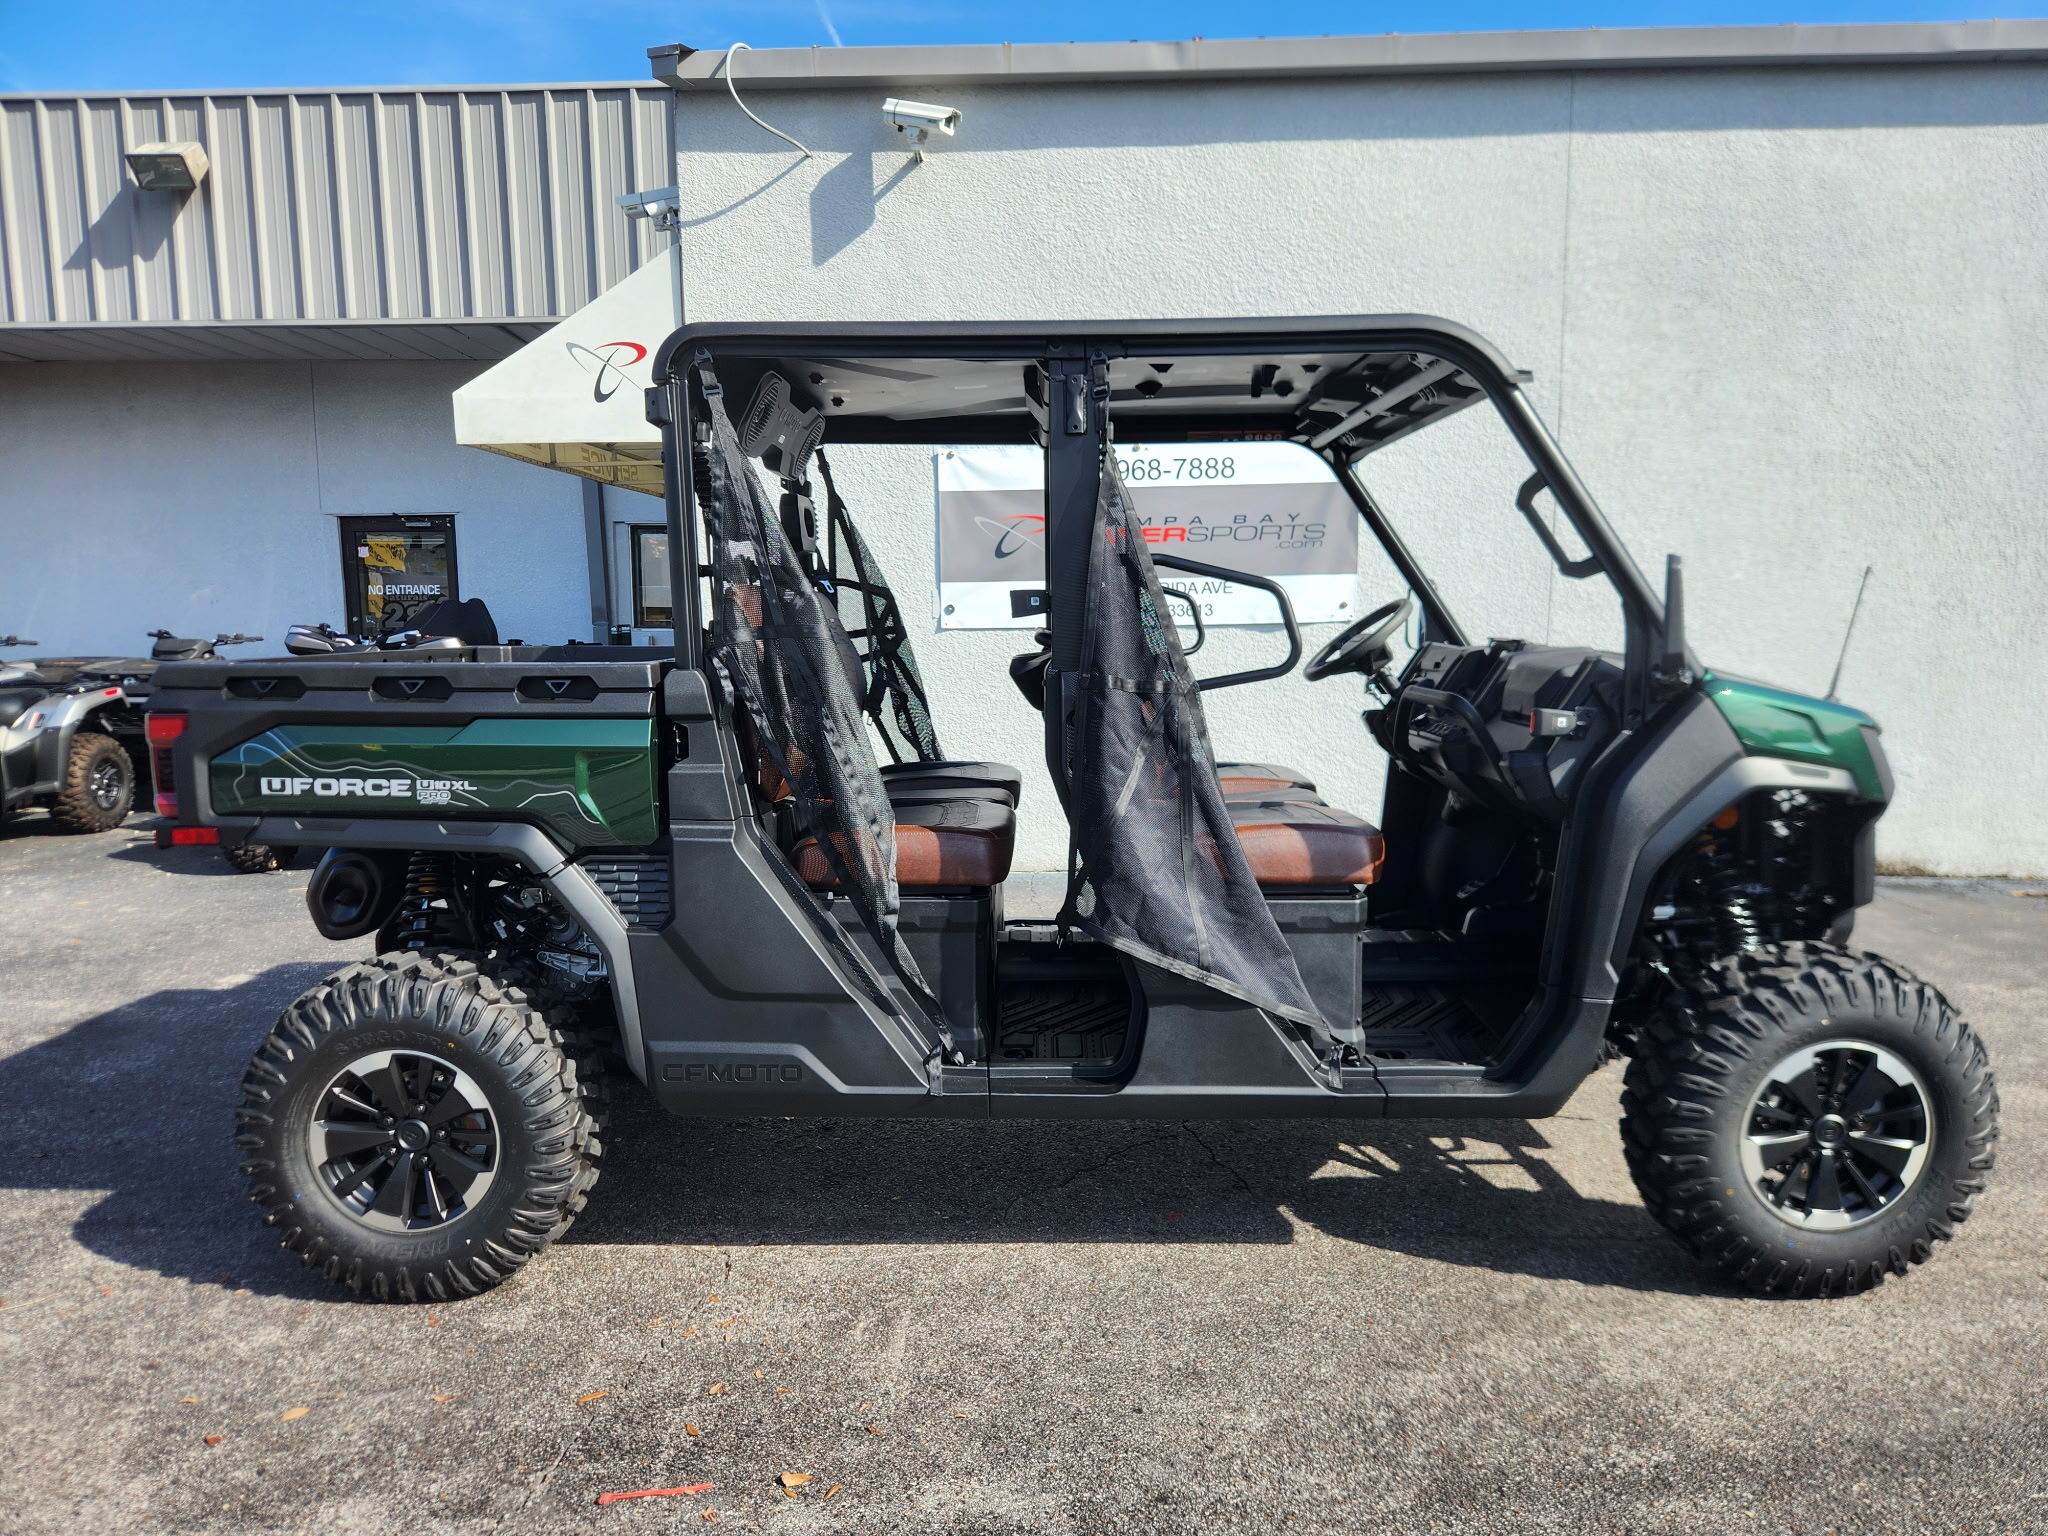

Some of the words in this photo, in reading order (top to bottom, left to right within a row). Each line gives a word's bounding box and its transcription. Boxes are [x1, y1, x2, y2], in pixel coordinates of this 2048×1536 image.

[1137, 515, 1203, 526] MPA
[1233, 513, 1300, 525] BAY
[1275, 539, 1323, 549] .com
[368, 585, 383, 595] NO
[386, 584, 440, 595] ENTRANCE
[1201, 581, 1233, 594] AVE
[261, 777, 412, 797] UFORCE
[416, 790, 451, 800] PRO
[662, 1063, 802, 1083] CFMOTO
